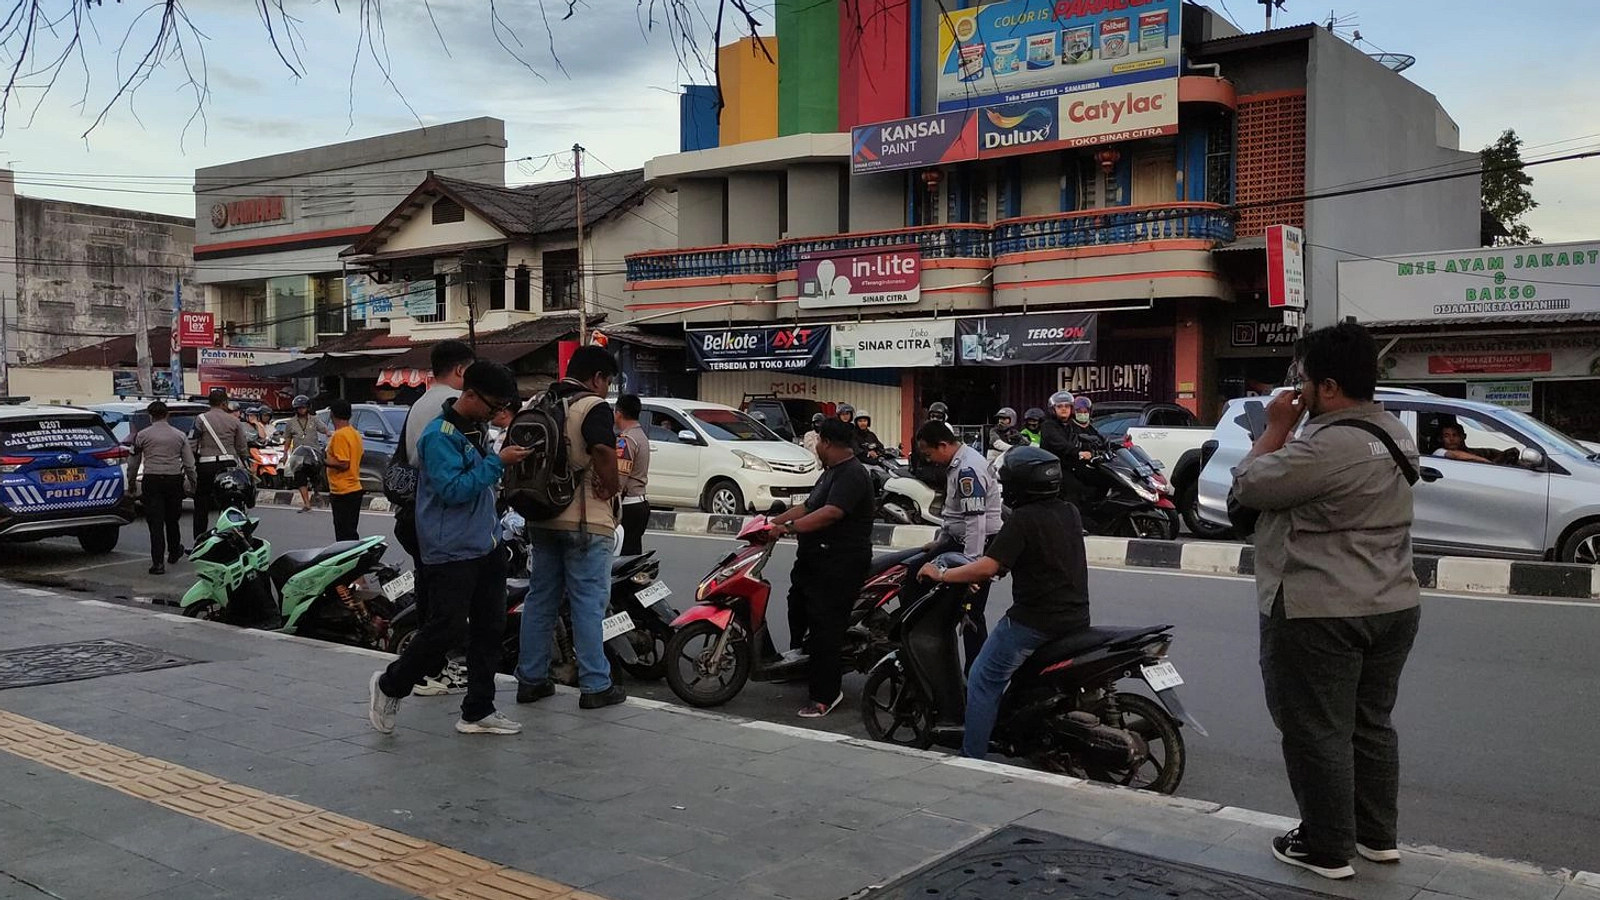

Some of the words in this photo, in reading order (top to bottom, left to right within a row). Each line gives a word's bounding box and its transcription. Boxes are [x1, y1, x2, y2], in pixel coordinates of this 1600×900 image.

[994, 13, 1034, 28] COLOR
[1037, 11, 1049, 21] IS
[1005, 94, 1020, 102] Toko
[1020, 91, 1039, 101] SINAR
[1039, 88, 1058, 98] CITRA
[1064, 81, 1100, 94] SAMARINDA
[1068, 93, 1163, 124] Catylac
[881, 119, 945, 143] KANSAI
[985, 129, 1044, 149] Dulux
[1070, 136, 1099, 147] TOKO
[1099, 132, 1131, 143] SINAR
[1132, 127, 1163, 139] CITRA
[881, 140, 917, 156] PAINT
[1397, 261, 1436, 276] MIE
[1445, 256, 1504, 273] AYAM
[1513, 249, 1599, 269] JAKART
[1494, 271, 1506, 285] &
[862, 294, 885, 303] SINAR
[886, 293, 908, 302] CITRA
[1465, 284, 1535, 302] BAKSO
[1433, 303, 1483, 315] DIJAMIN
[703, 332, 757, 351] Belkote
[772, 327, 812, 349] AXT
[909, 328, 930, 338] Toko
[1027, 326, 1086, 340] TEROSON
[857, 339, 894, 352] SINAR
[895, 336, 931, 350] CITRA
[228, 351, 255, 359] PRIMA
[709, 361, 748, 370] TERSEDIA
[749, 361, 758, 369] DI
[761, 360, 783, 368] TOKO
[784, 359, 807, 368] KAMI
[1057, 366, 1110, 394] CARI
[1112, 364, 1152, 395] CAT?
[229, 387, 268, 396] NIPPON
[4, 437, 28, 447] CALL
[29, 435, 64, 443] CENTER
[11, 429, 51, 439] POLRESTA
[51, 428, 94, 436] SAMARINDA
[46, 487, 86, 499] POLISI
